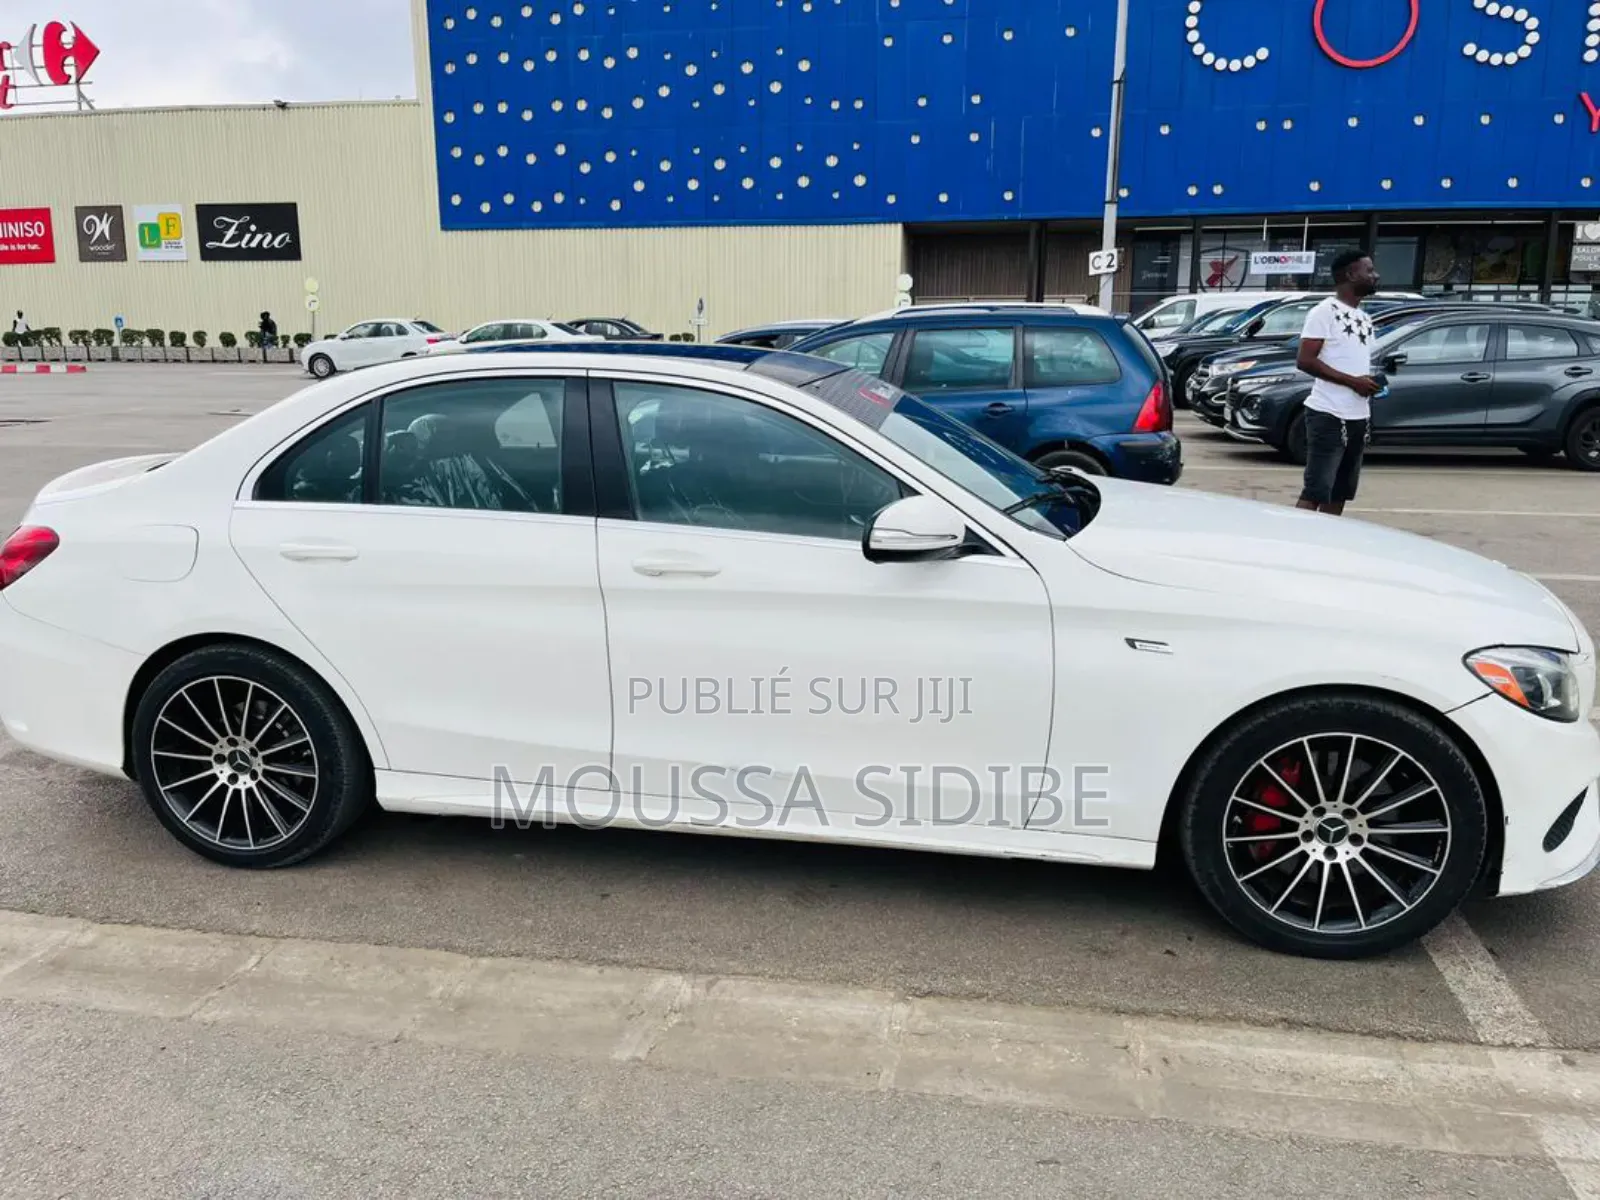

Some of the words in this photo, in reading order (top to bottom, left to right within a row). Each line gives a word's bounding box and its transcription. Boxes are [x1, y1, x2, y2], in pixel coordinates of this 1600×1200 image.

[205, 215, 293, 249] Zino
[1091, 255, 1102, 270] C
[1106, 252, 1115, 269] 2
